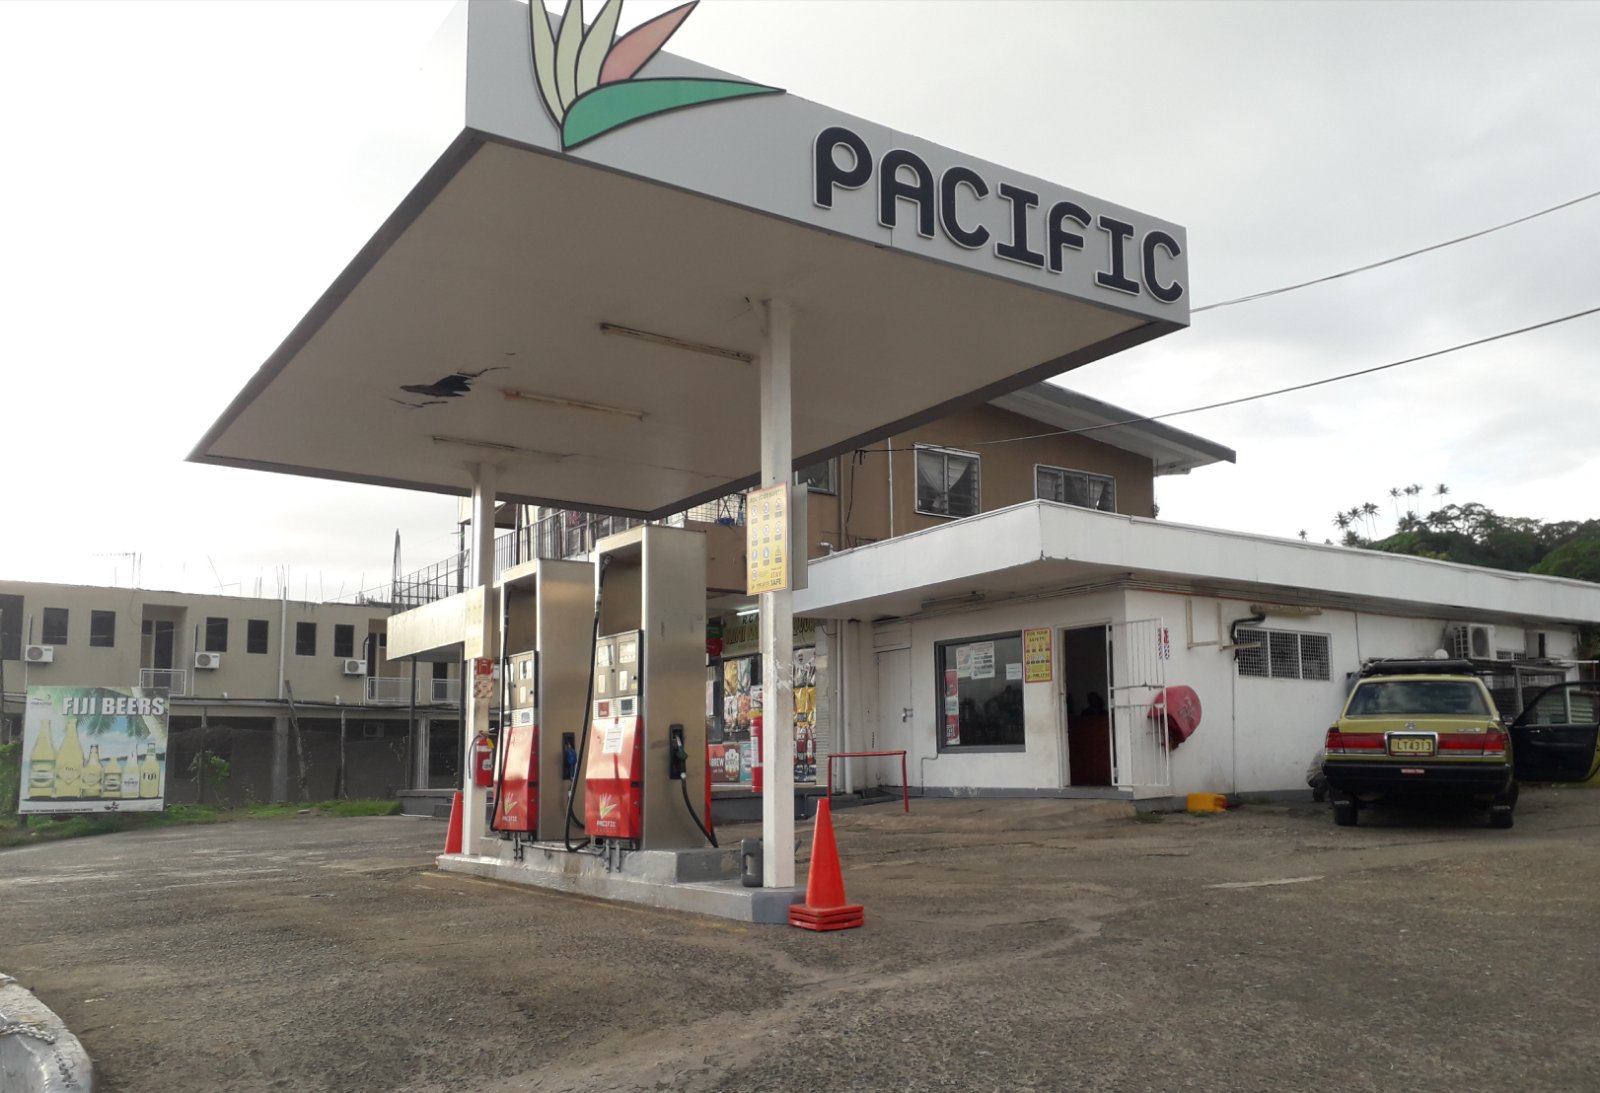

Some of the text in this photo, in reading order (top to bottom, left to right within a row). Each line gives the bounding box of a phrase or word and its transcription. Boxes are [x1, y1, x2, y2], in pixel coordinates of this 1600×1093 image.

[813, 126, 1183, 304] PACIFIC
[62, 697, 166, 715] FIJI BEERS
